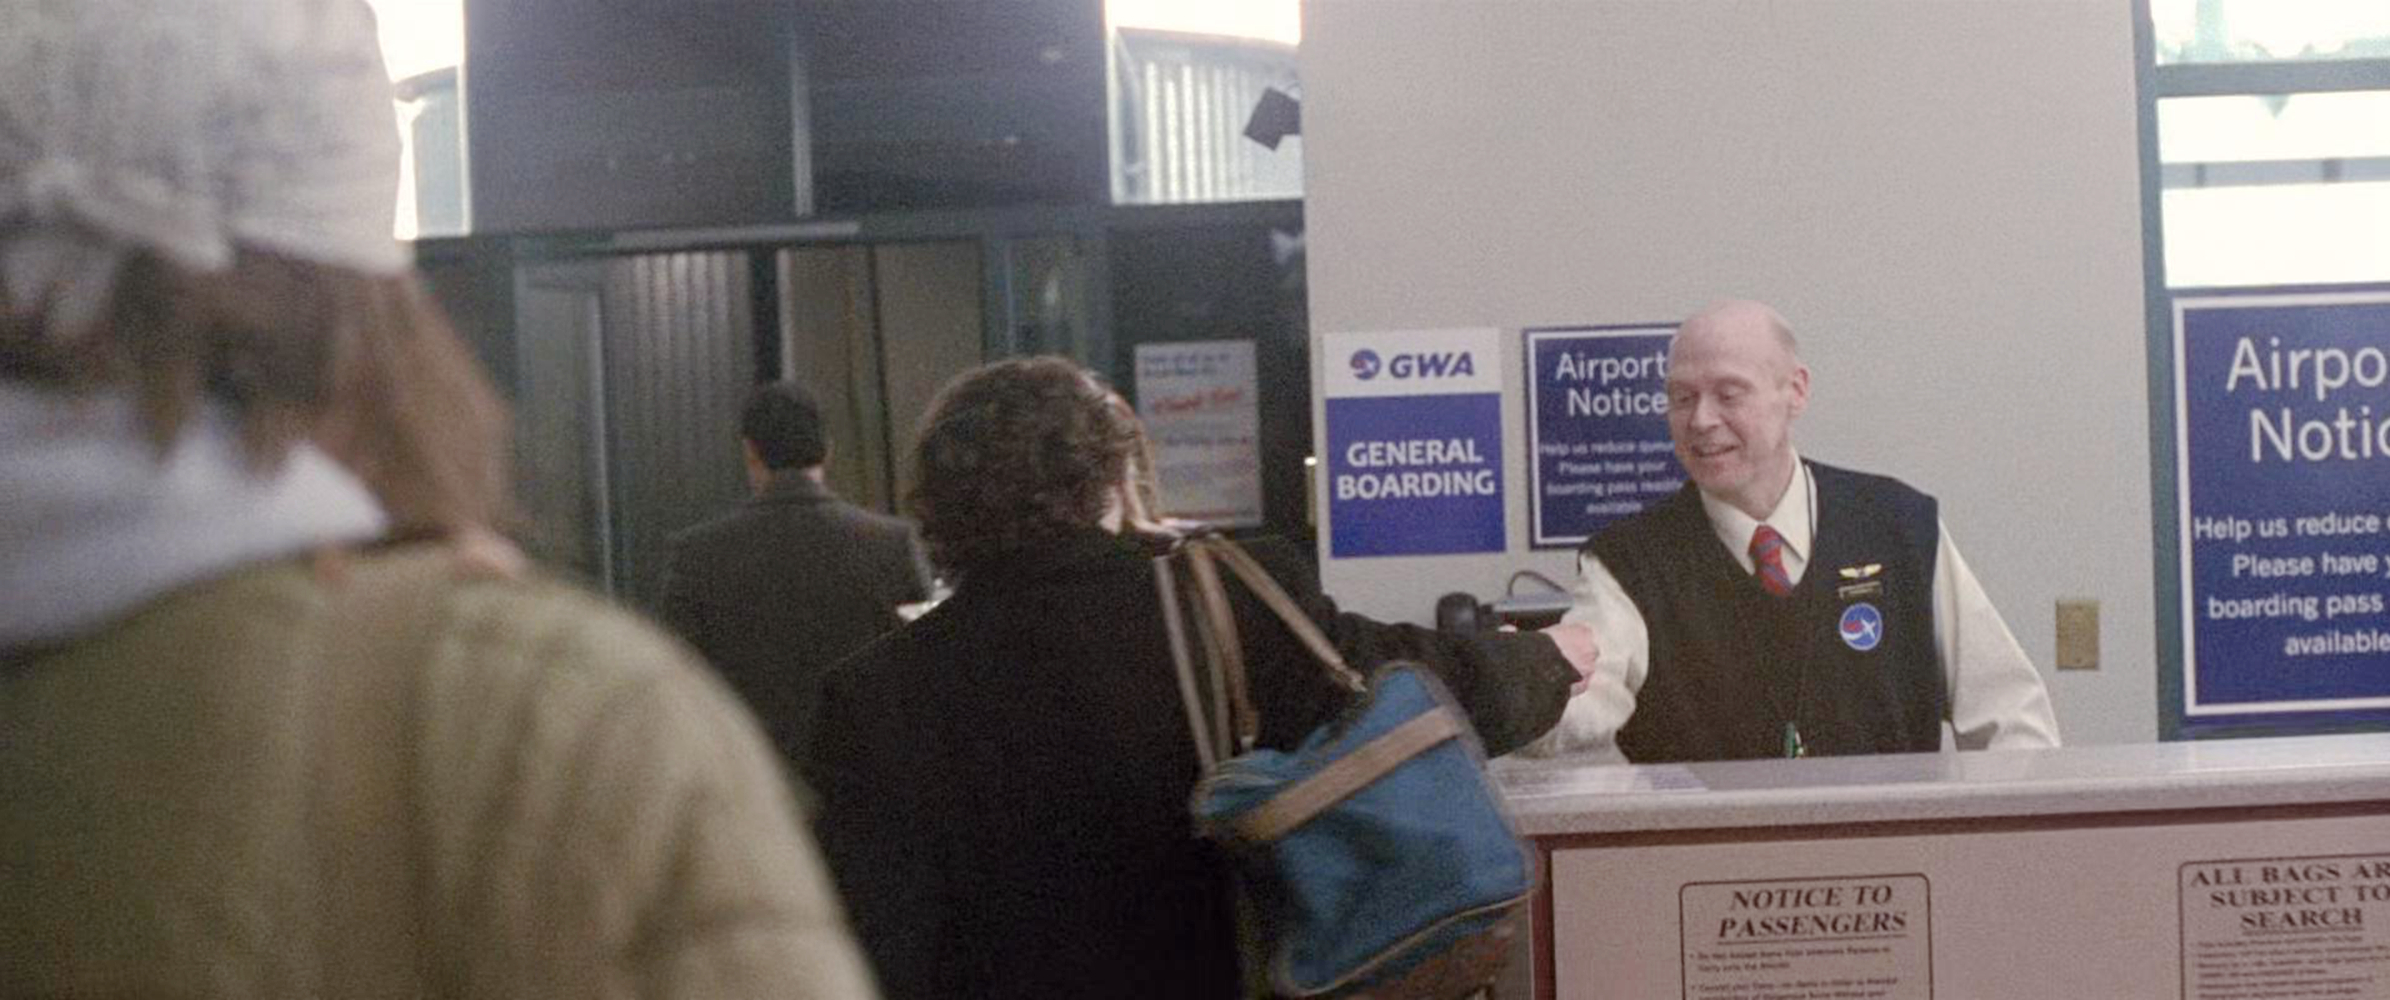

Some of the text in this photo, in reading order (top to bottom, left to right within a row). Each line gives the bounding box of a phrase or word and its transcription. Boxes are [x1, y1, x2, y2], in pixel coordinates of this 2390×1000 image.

[1389, 351, 1475, 379] GWA
[1556, 351, 1667, 386] Airport
[2226, 336, 2388, 401] Airpo
[1567, 386, 1670, 417] Notice
[1346, 438, 1483, 467] GENERAL
[1337, 469, 1496, 500] BOARDING
[2194, 515, 2252, 543] Help
[2259, 517, 2288, 538] us
[2296, 511, 2380, 536] reduce
[2232, 553, 2315, 578] Please
[2321, 551, 2378, 575] have
[2208, 590, 2384, 621] boarding pass
[2285, 629, 2390, 656] available
[2191, 867, 2243, 887] ALL
[2261, 864, 2341, 883] BAGS
[1729, 885, 1893, 911] NOTICE TO
[2209, 884, 2390, 908] SUBJECT TO
[1717, 911, 1908, 938] PASSENGERS
[2240, 907, 2363, 928] SEARCH
